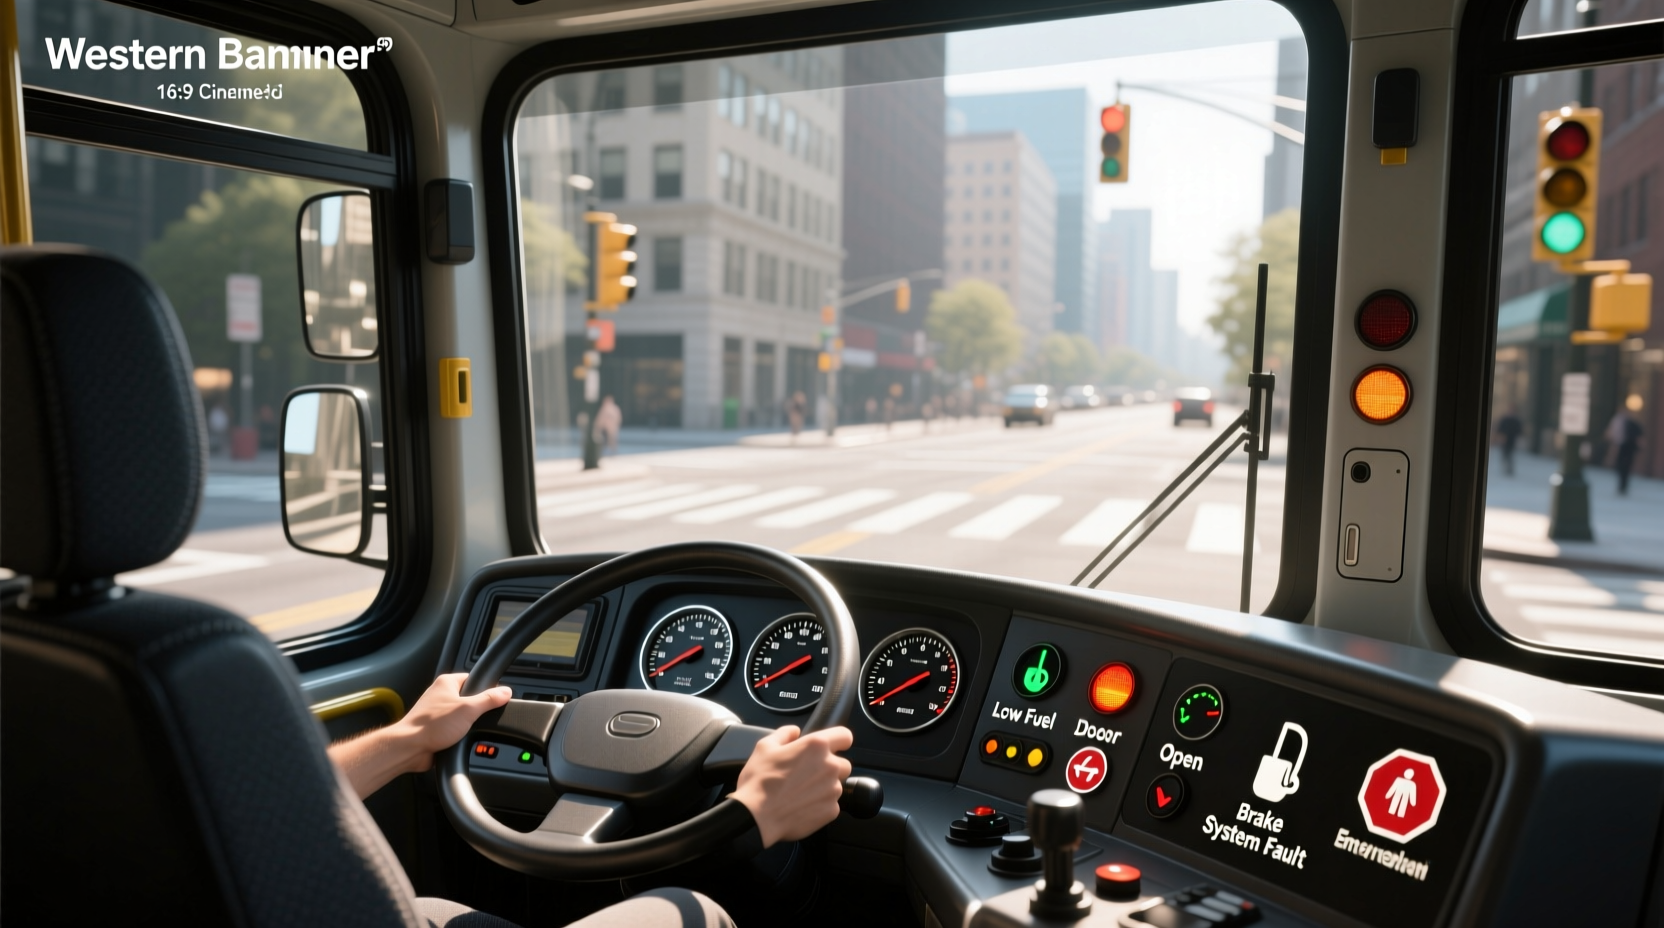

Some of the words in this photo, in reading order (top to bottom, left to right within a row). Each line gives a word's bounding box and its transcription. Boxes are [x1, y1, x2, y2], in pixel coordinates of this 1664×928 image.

[991, 700, 1023, 723] Low
[1024, 707, 1058, 731] Fuel
[1159, 743, 1204, 772] Open
[1235, 802, 1284, 833] Brake
[1202, 814, 1261, 852] System
[1262, 836, 1307, 870] Fault
